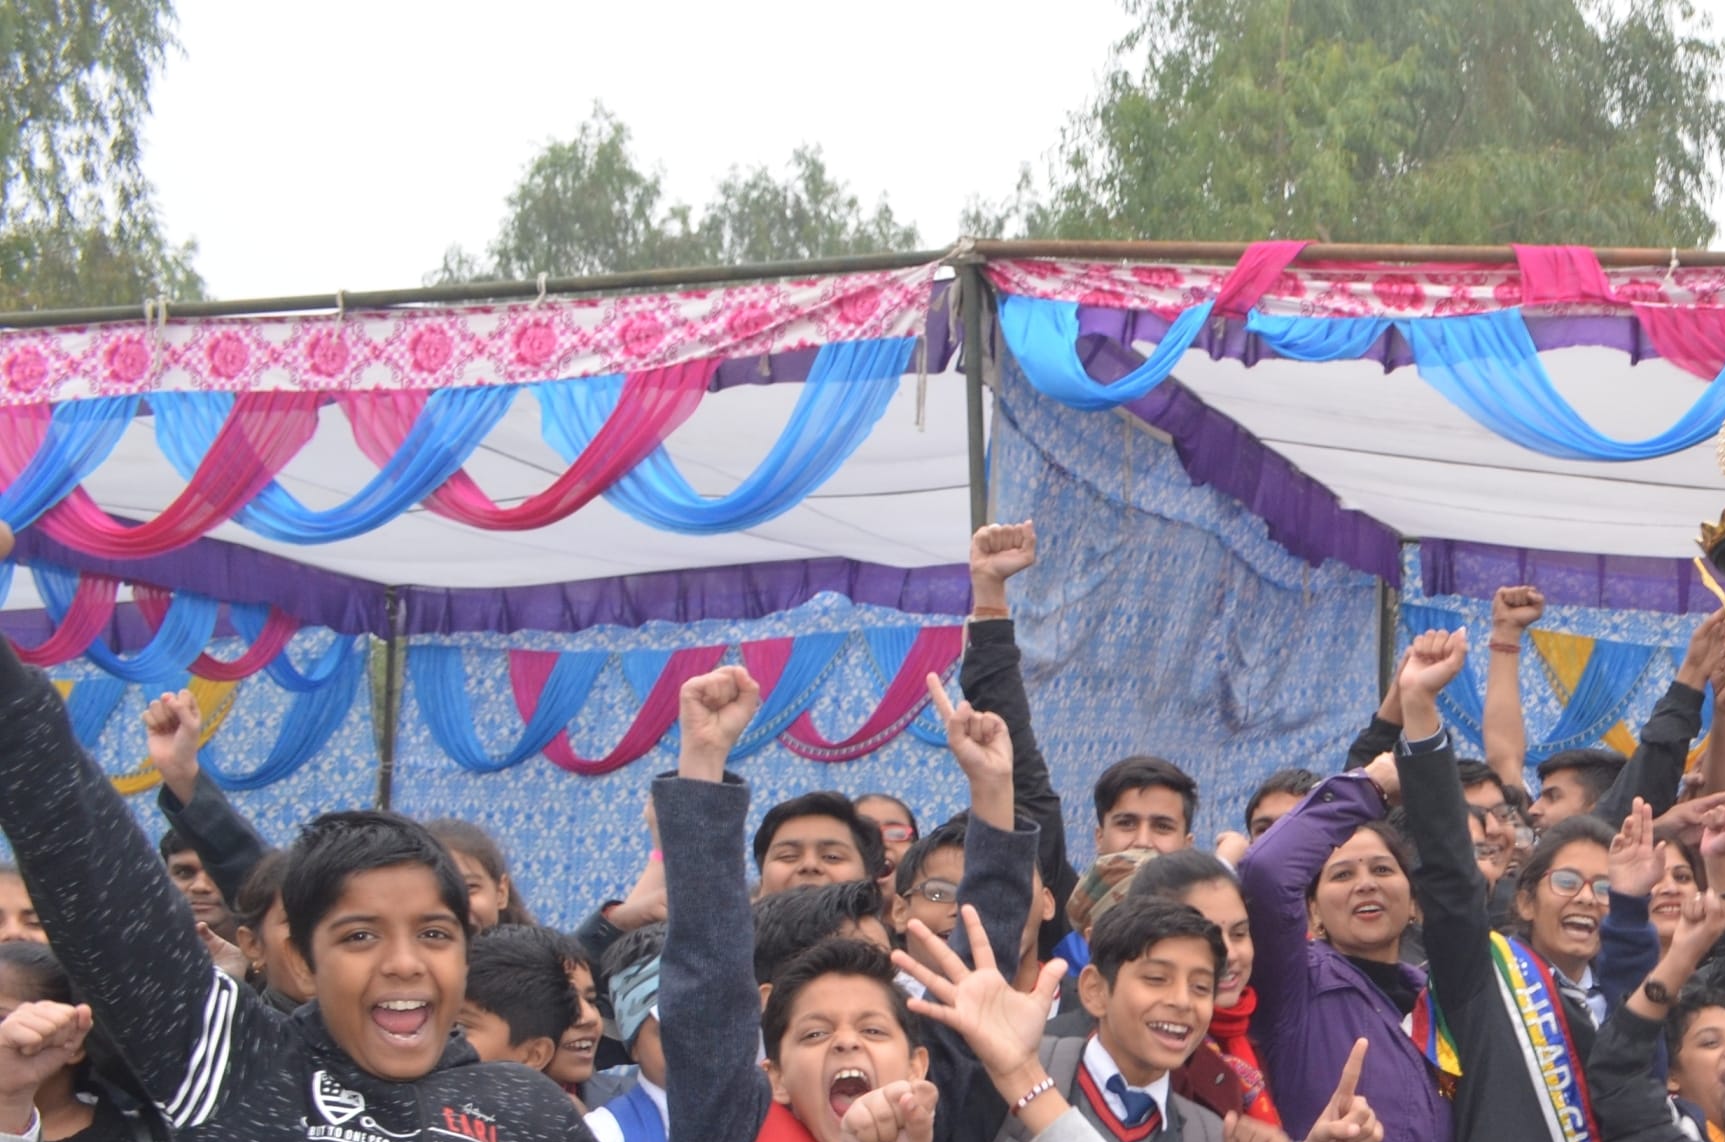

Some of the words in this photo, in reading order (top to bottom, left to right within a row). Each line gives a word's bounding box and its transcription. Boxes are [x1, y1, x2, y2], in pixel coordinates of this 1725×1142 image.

[1516, 982, 1571, 1093] HEAD
[308, 1126, 326, 1137] BUT
[328, 1126, 343, 1137] TO
